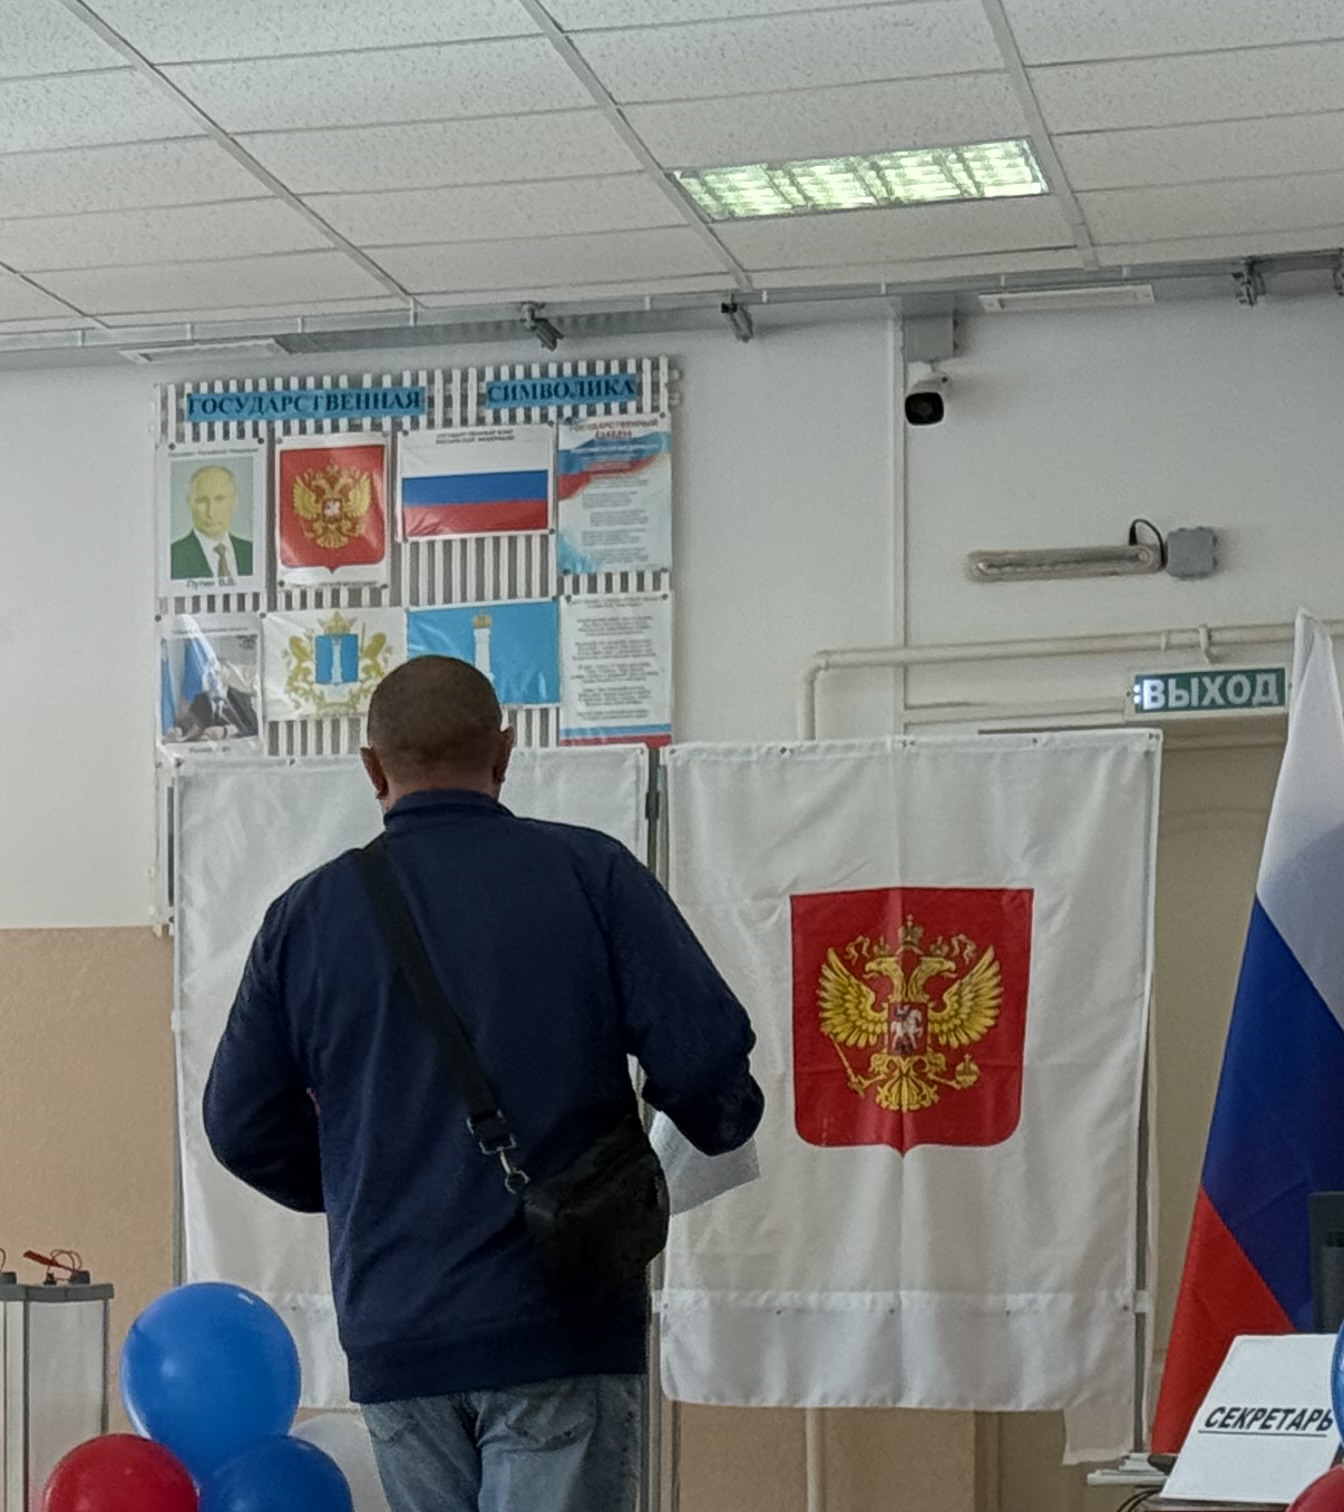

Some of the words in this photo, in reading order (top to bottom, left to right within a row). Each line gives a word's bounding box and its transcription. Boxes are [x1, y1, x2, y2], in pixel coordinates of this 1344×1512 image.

[187, 390, 421, 416] ГОСУДАРСТВЕННАЯ
[486, 379, 635, 403] СИМВОЛИКА
[1142, 673, 1280, 711] ВЫХОД
[1204, 1406, 1334, 1432] СЕКРЕТАРЬ
